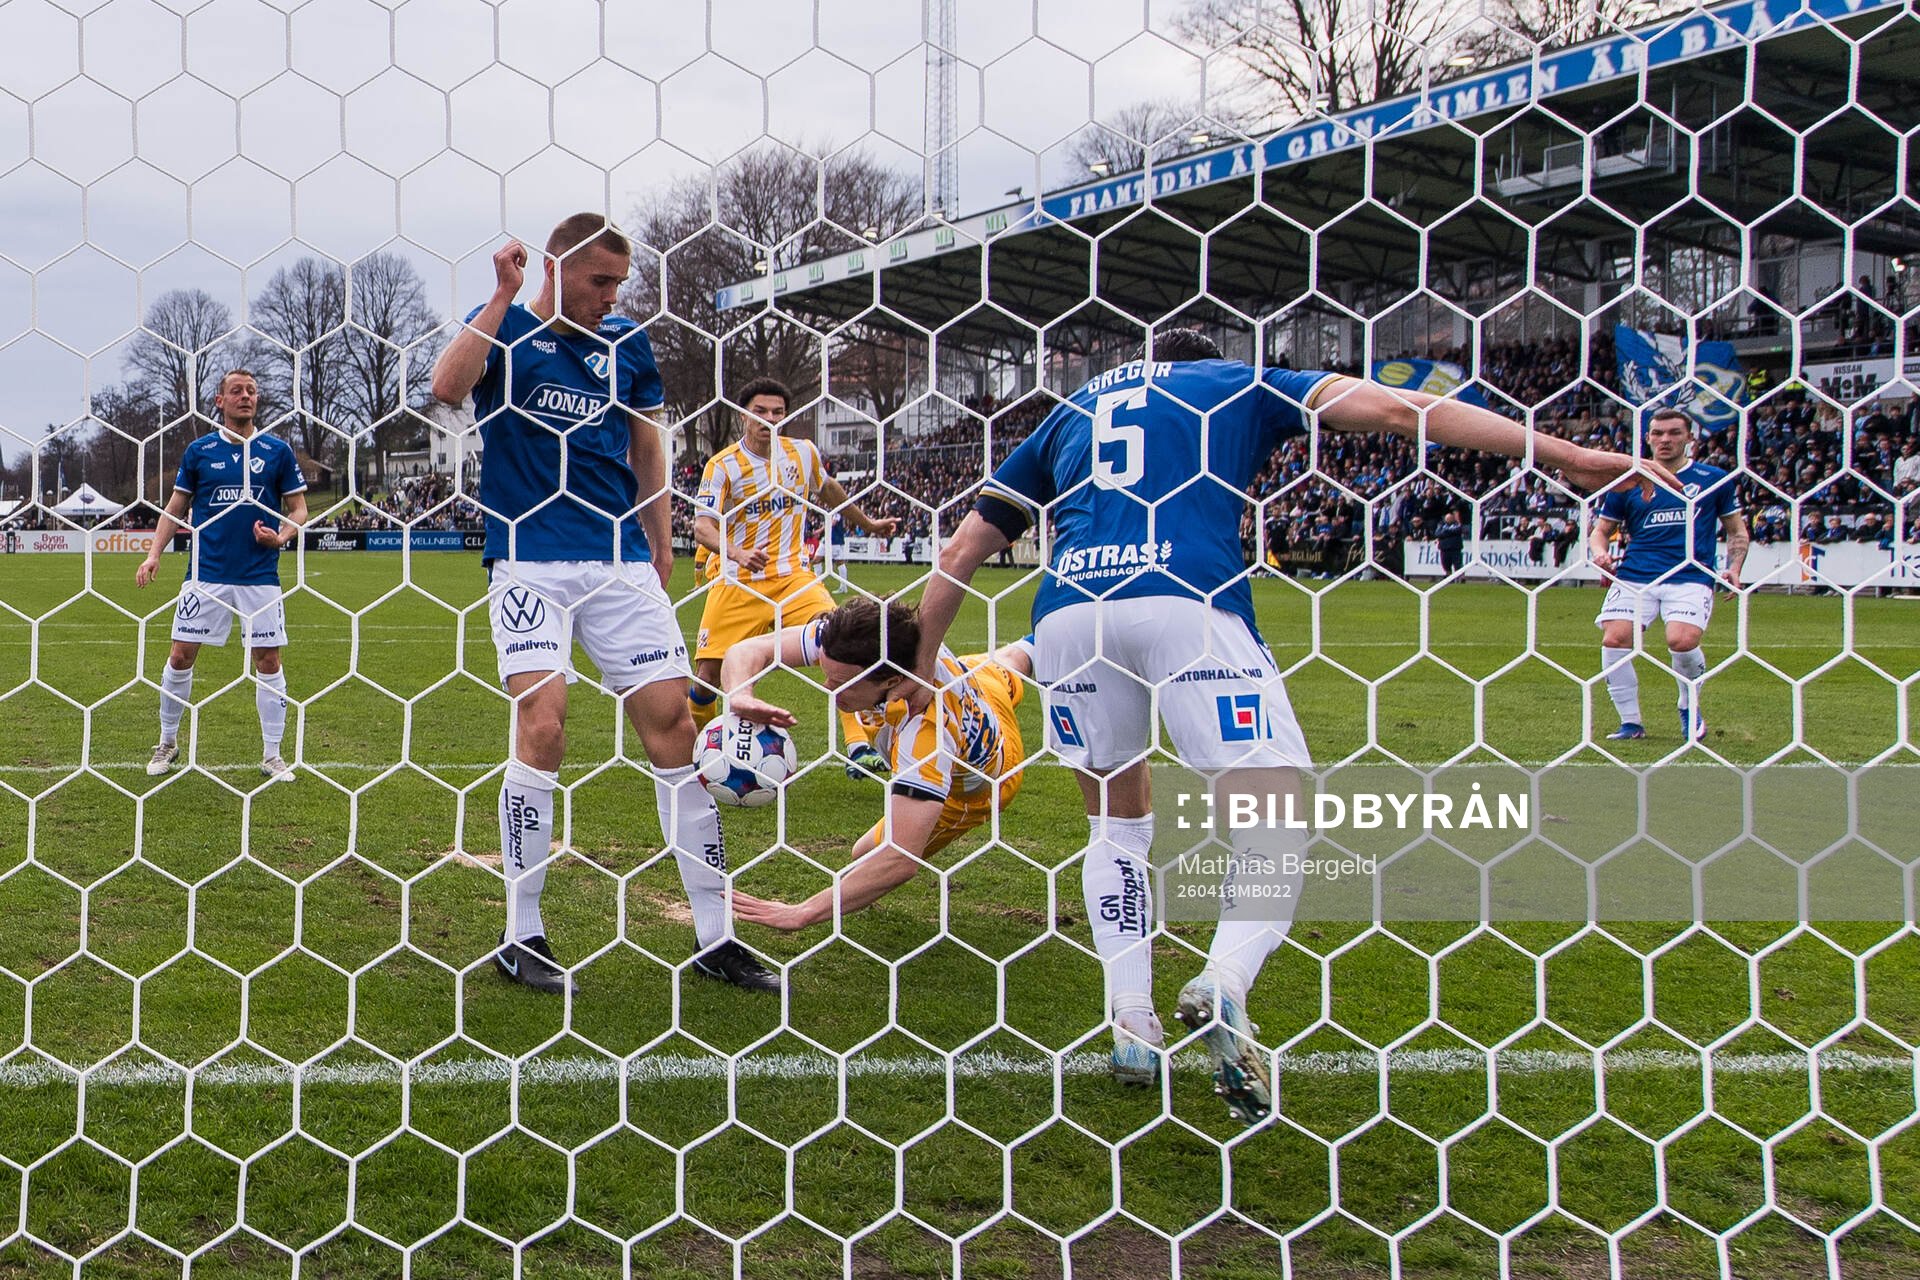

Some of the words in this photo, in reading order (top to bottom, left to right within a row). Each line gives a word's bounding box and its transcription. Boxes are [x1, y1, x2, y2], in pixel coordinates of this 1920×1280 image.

[532, 339, 556, 350] sport
[1833, 364, 1863, 376] NISSAN
[1093, 387, 1147, 491] 5
[41, 534, 65, 543] Bygg
[318, 539, 357, 548] Transport
[323, 533, 338, 541] GN
[369, 537, 403, 546] NORDI
[630, 646, 680, 666] villalivt
[736, 718, 754, 761] SELEC
[524, 806, 539, 831] GN
[511, 794, 526, 870] Transport
[703, 843, 720, 868] GN
[1113, 858, 1138, 933] Transport
[1099, 894, 1121, 922] GN
